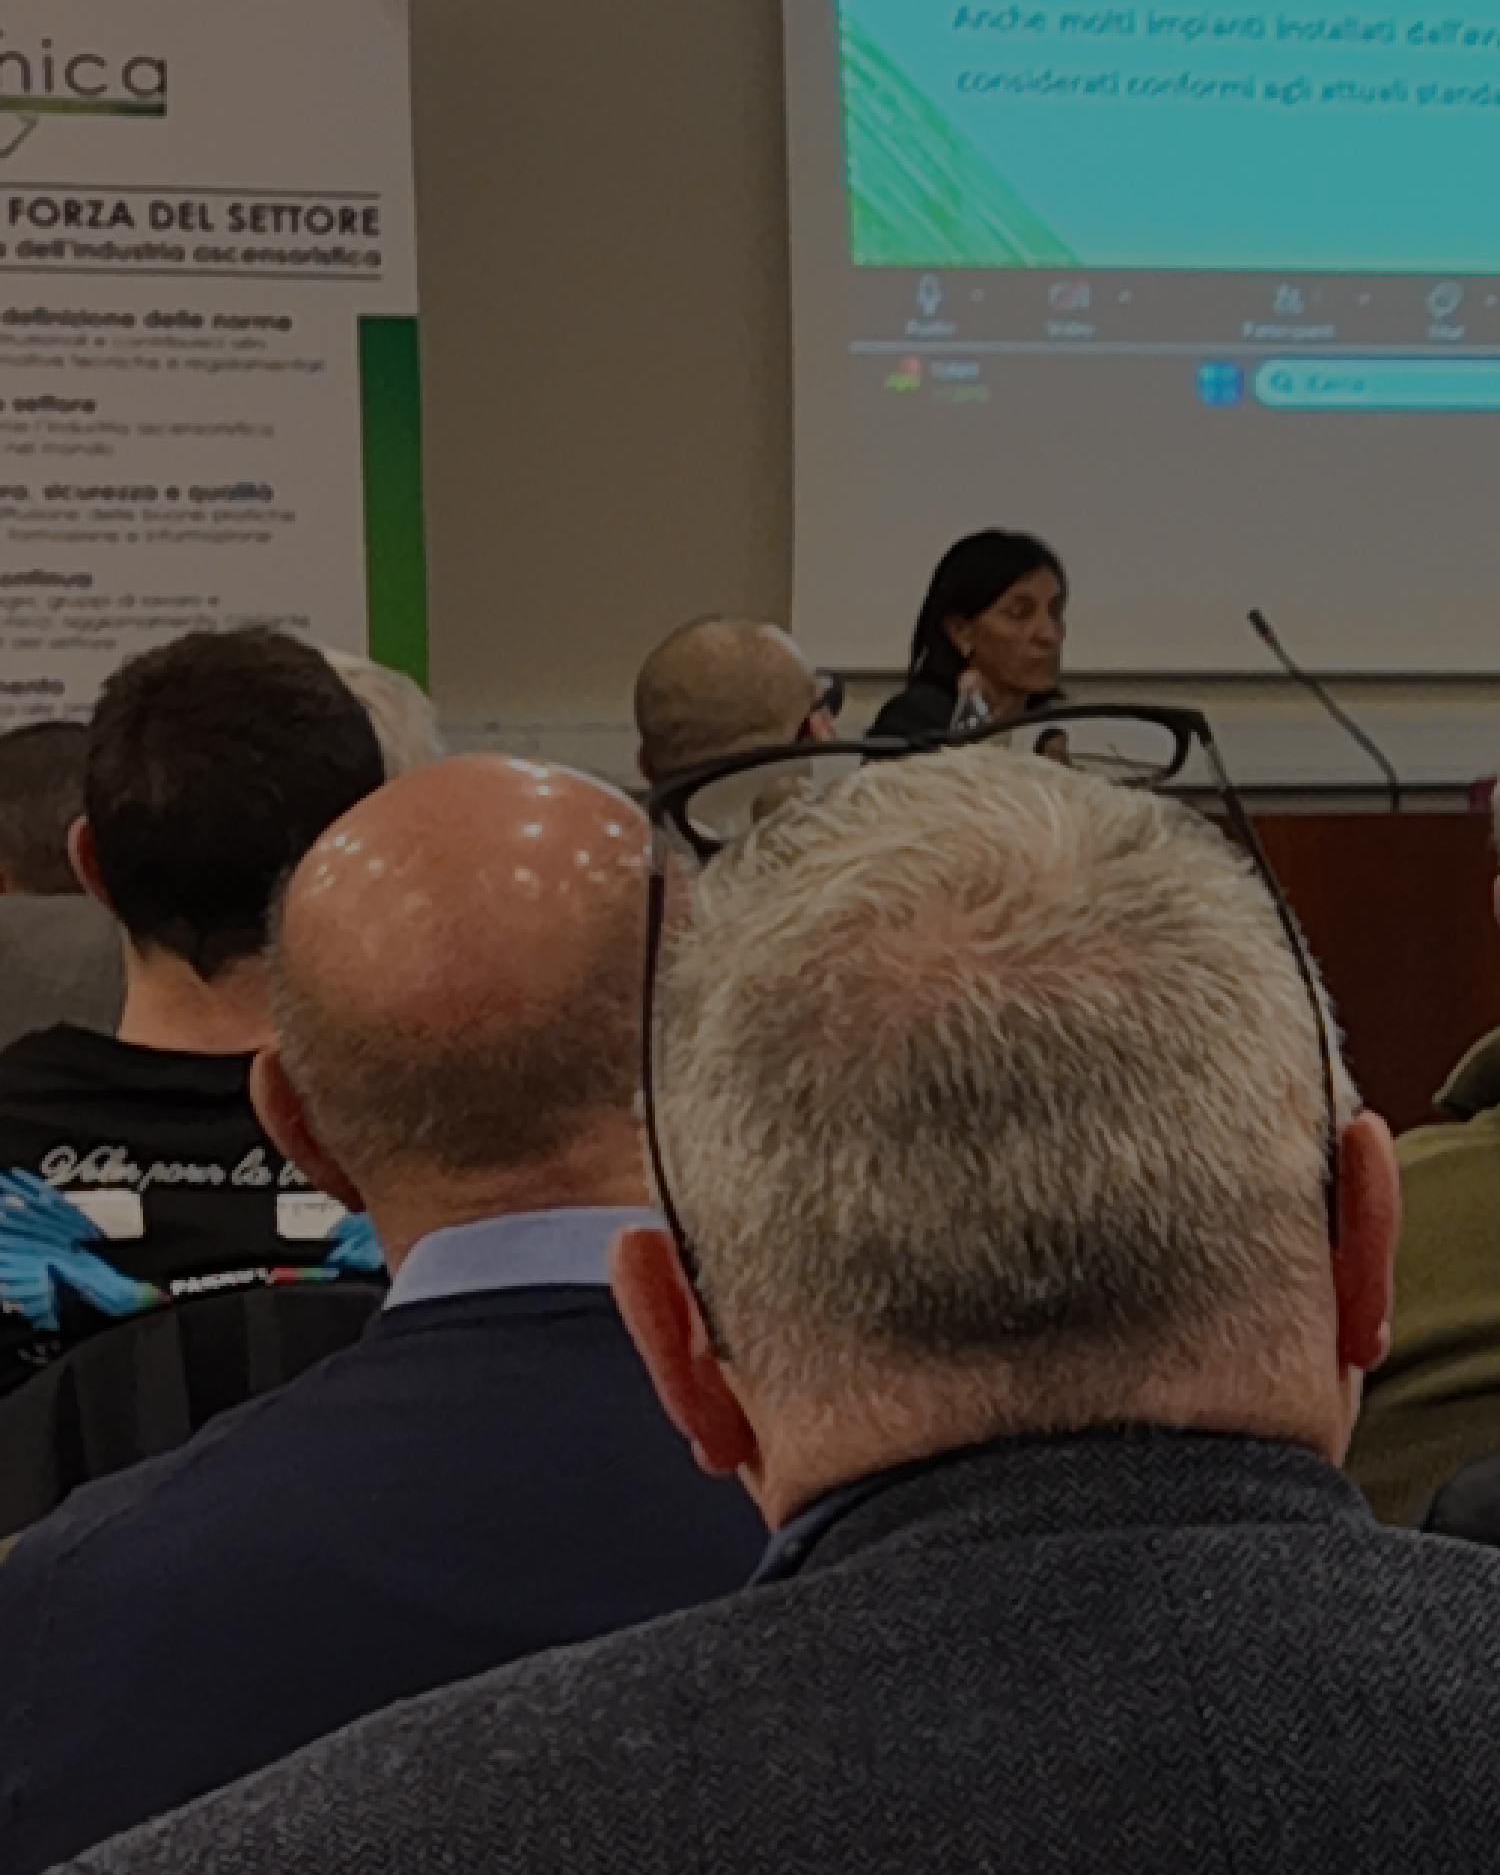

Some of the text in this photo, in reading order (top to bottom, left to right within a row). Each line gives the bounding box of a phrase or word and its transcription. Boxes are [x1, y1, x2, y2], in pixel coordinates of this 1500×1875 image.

[8, 196, 381, 238] FORZA DEL SETTORE
